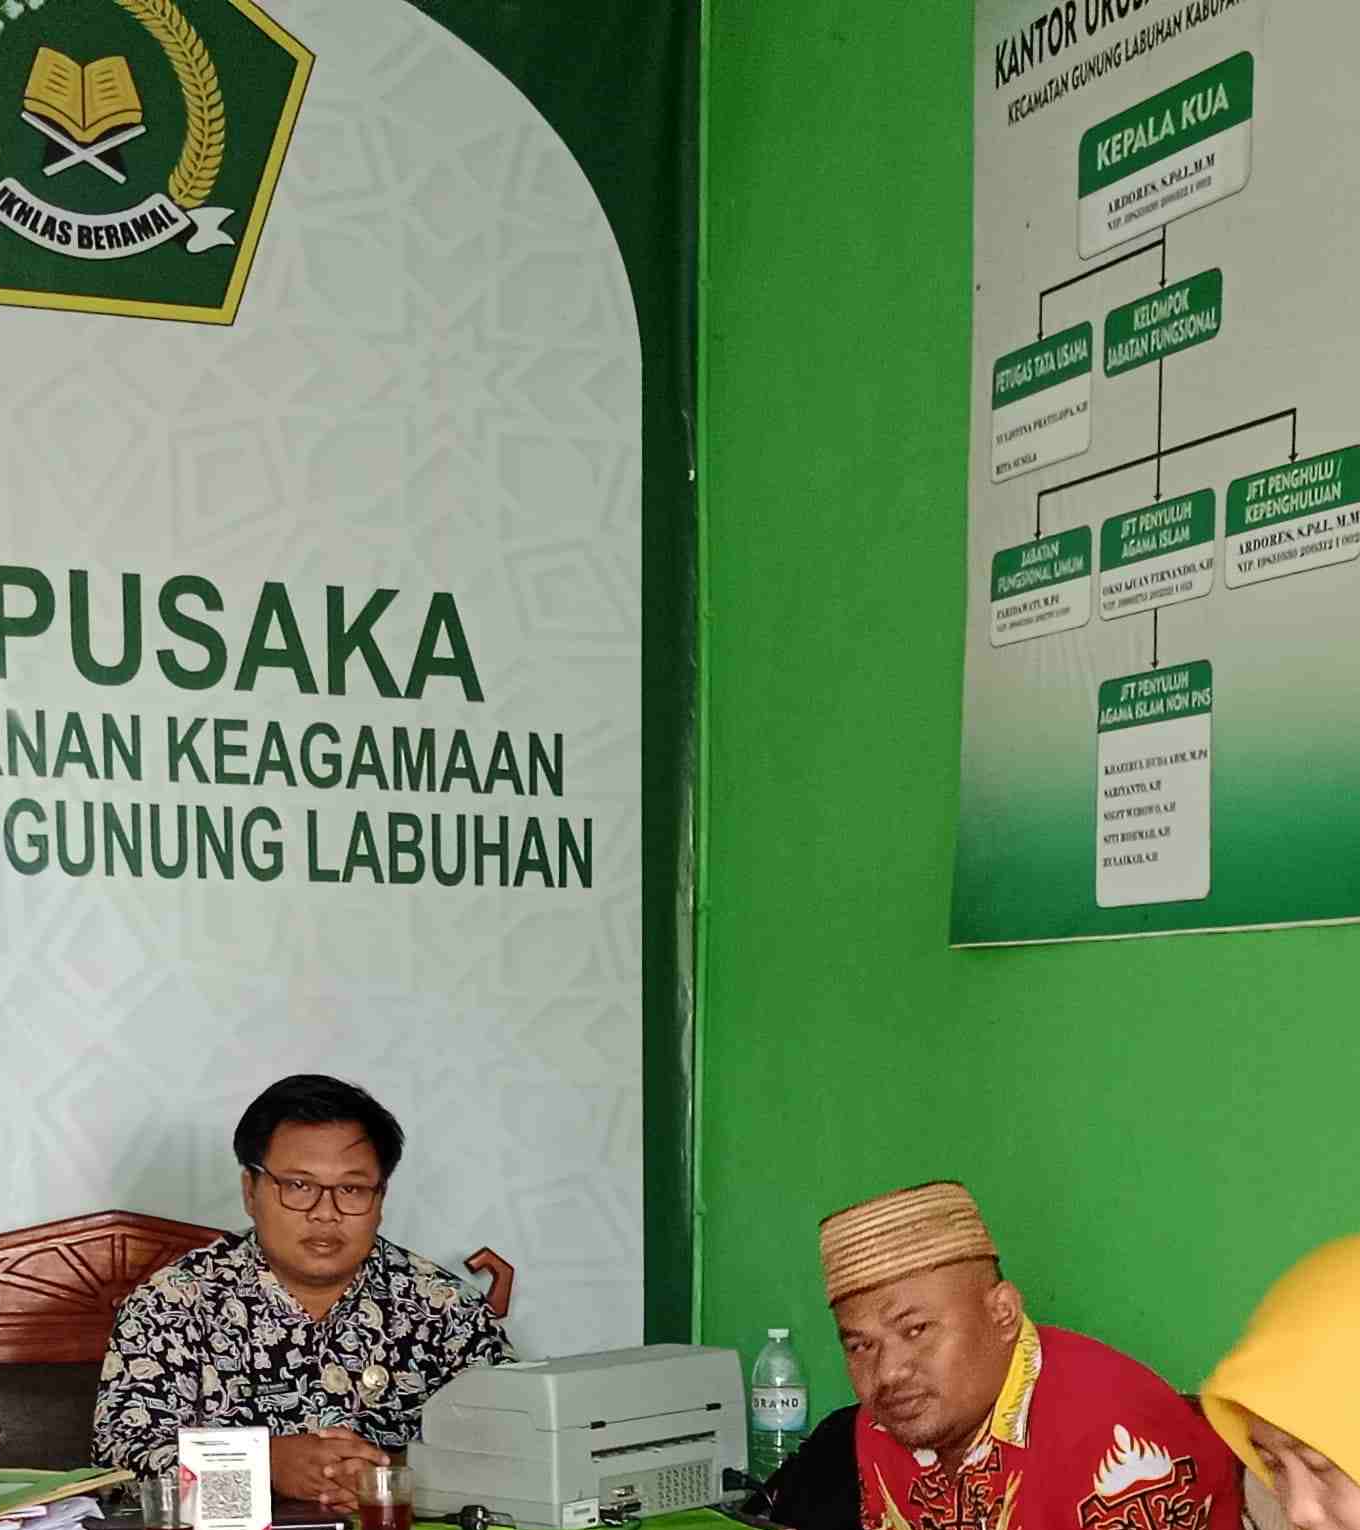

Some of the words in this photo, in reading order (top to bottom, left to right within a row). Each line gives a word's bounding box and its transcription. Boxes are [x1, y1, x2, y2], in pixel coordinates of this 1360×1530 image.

[996, 0, 1078, 90] KANTOR
[1008, 71, 1069, 127] KECAMATAN
[1071, 41, 1122, 91] GUNUNG
[1124, 8, 1183, 63] LABUHAN
[1097, 108, 1175, 172] KEPALA
[1182, 82, 1230, 130] KUA
[78, 203, 179, 250] BERAMAL
[1133, 288, 1190, 331] KELOMPOK
[1106, 336, 1149, 371] JABATAN
[1150, 307, 1218, 353] FUNGSIONAL
[996, 358, 1033, 393] PETUGAS
[1034, 352, 1056, 376] TATA
[1056, 339, 1088, 369] USAHA
[1245, 482, 1342, 525] KEPENGHULUAN
[1246, 478, 1266, 502] JFT
[1268, 458, 1334, 496] PENGHULU
[1121, 517, 1138, 541] JFT
[1139, 501, 1193, 531] PENYULUH
[1121, 537, 1158, 559] AGAMA
[1158, 526, 1191, 548] ISLAM
[1100, 706, 1134, 725] AGAMA
[1135, 699, 1165, 719] ISLAM
[1166, 692, 1190, 712] NON
[1192, 687, 1213, 707] PNS
[1138, 671, 1189, 697] PENYULUH
[167, 716, 565, 797] KEAGAMAAN
[2, 796, 285, 884] GUNUNG
[306, 808, 595, 889] LABUHAN
